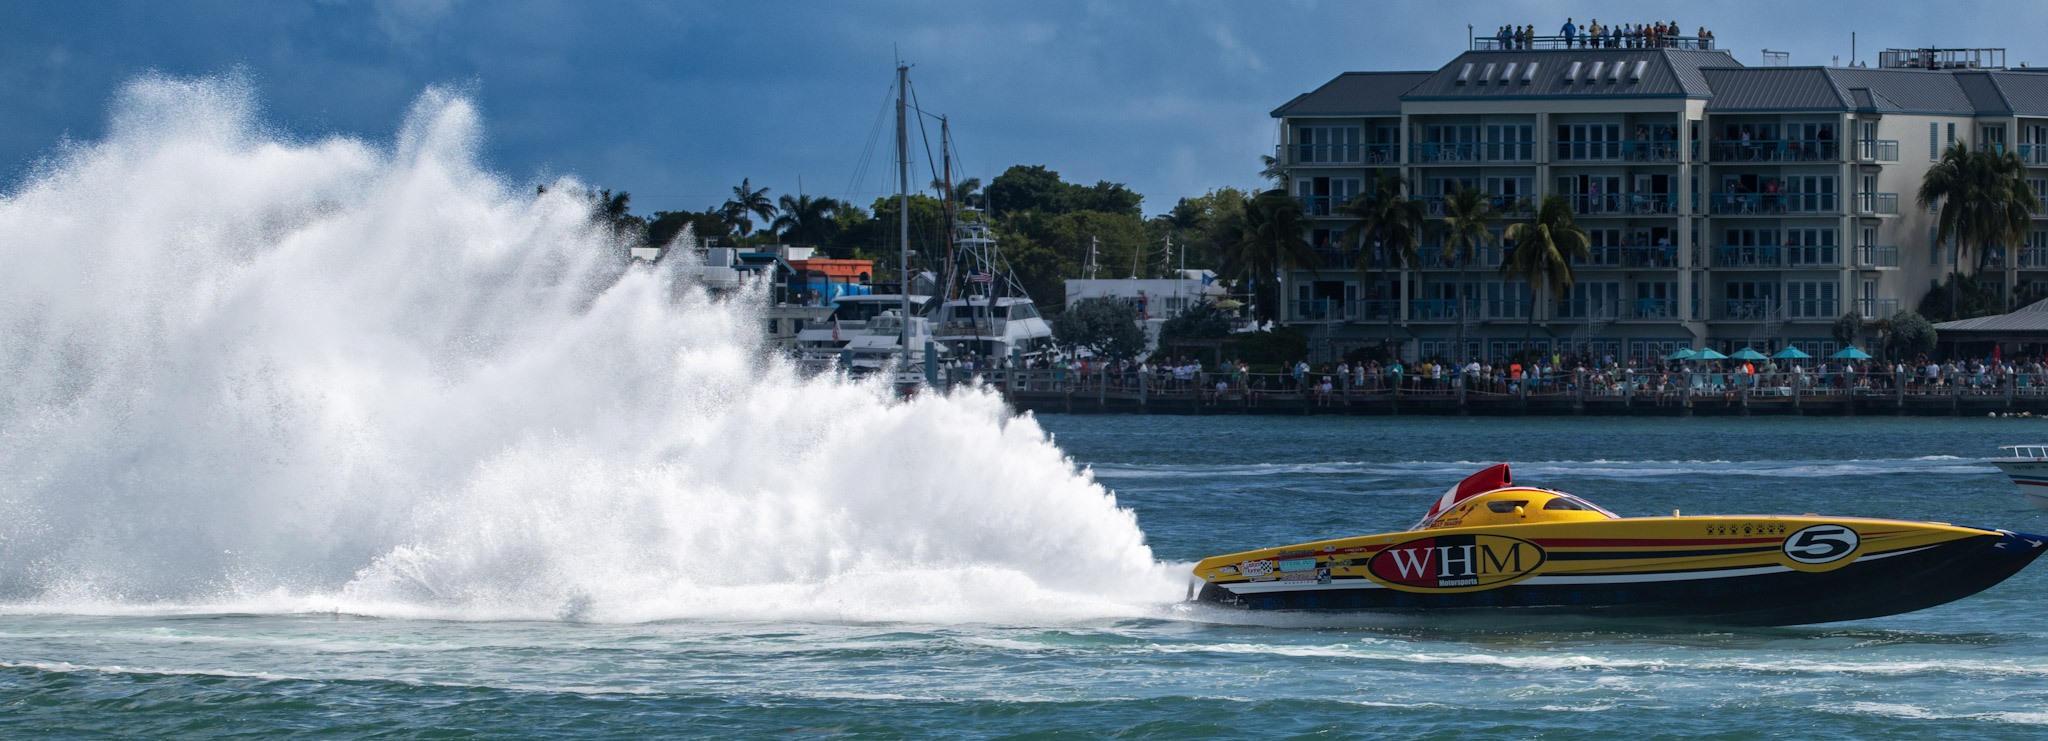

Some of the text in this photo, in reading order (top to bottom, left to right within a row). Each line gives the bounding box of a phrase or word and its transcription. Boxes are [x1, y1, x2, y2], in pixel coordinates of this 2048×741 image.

[1789, 529, 1851, 559] 5
[1388, 543, 1525, 579] WHM
[1439, 578, 1478, 587] Motorsports
